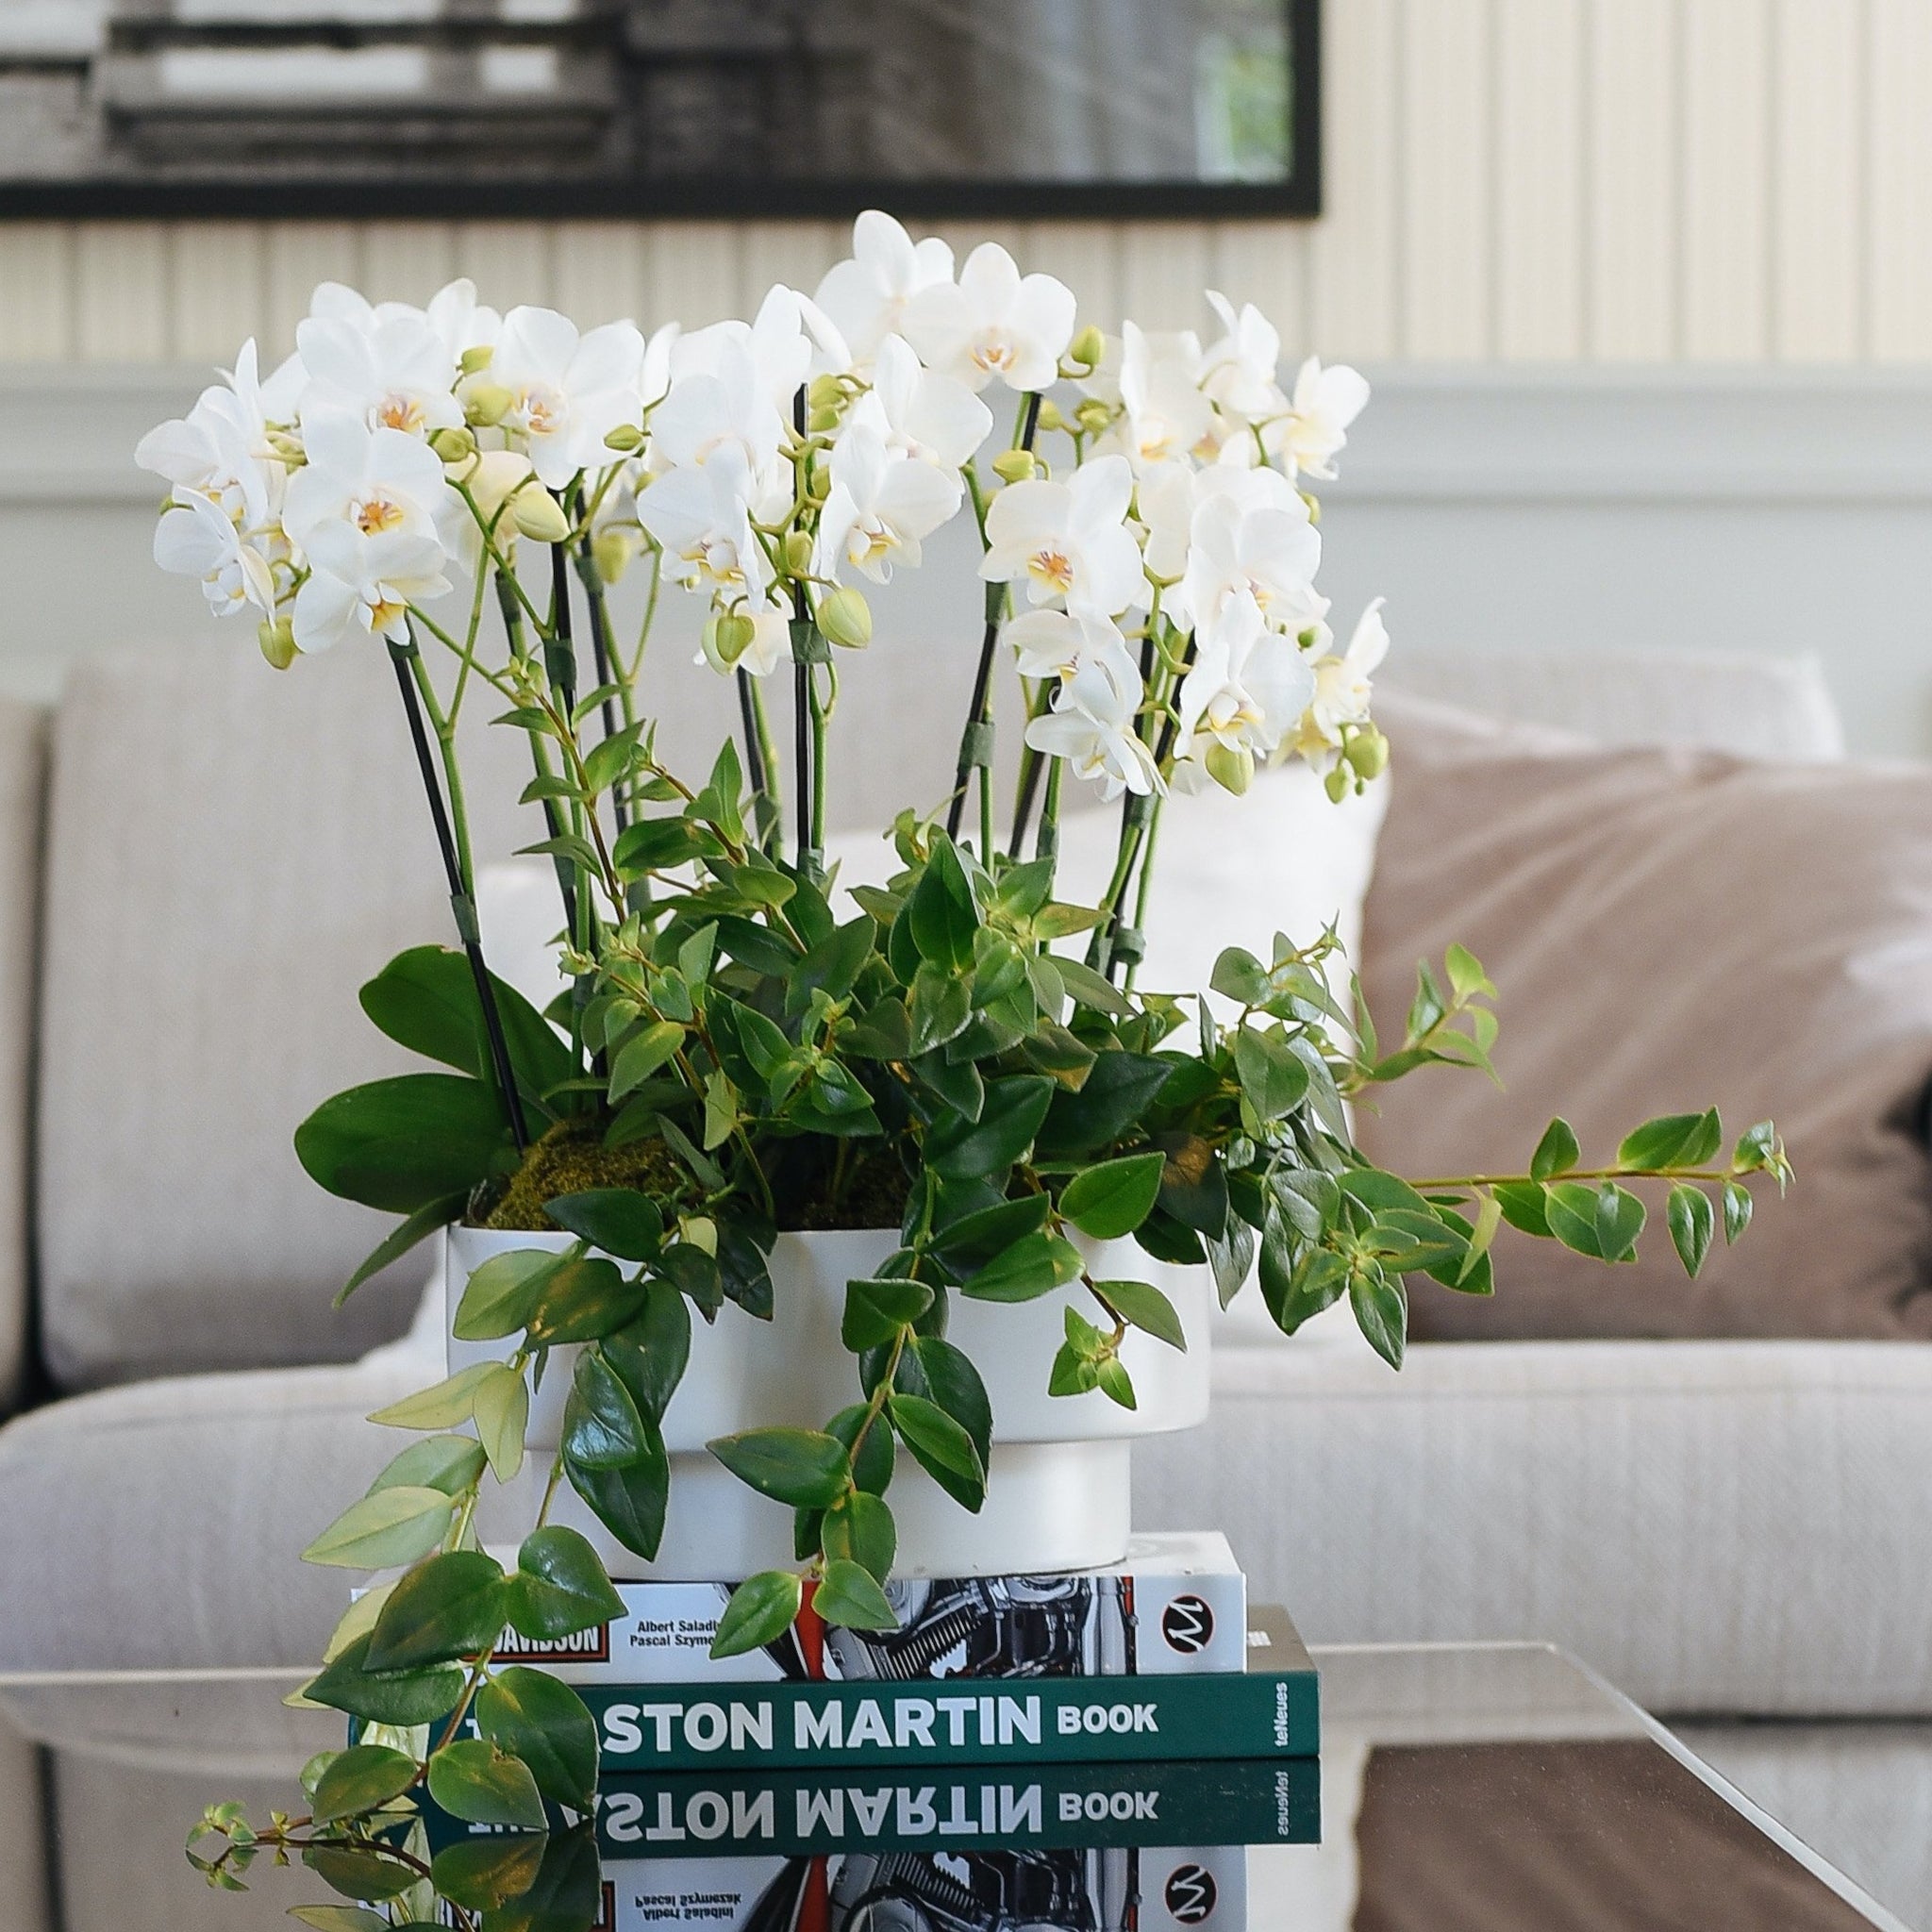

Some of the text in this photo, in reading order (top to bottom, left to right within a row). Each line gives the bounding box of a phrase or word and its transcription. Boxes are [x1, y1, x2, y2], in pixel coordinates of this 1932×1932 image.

[638, 1620, 720, 1633] Albert Saladi
[630, 1635, 716, 1648] Pascal Szyme
[598, 1695, 1159, 1754] STON MARTIN BOOK
